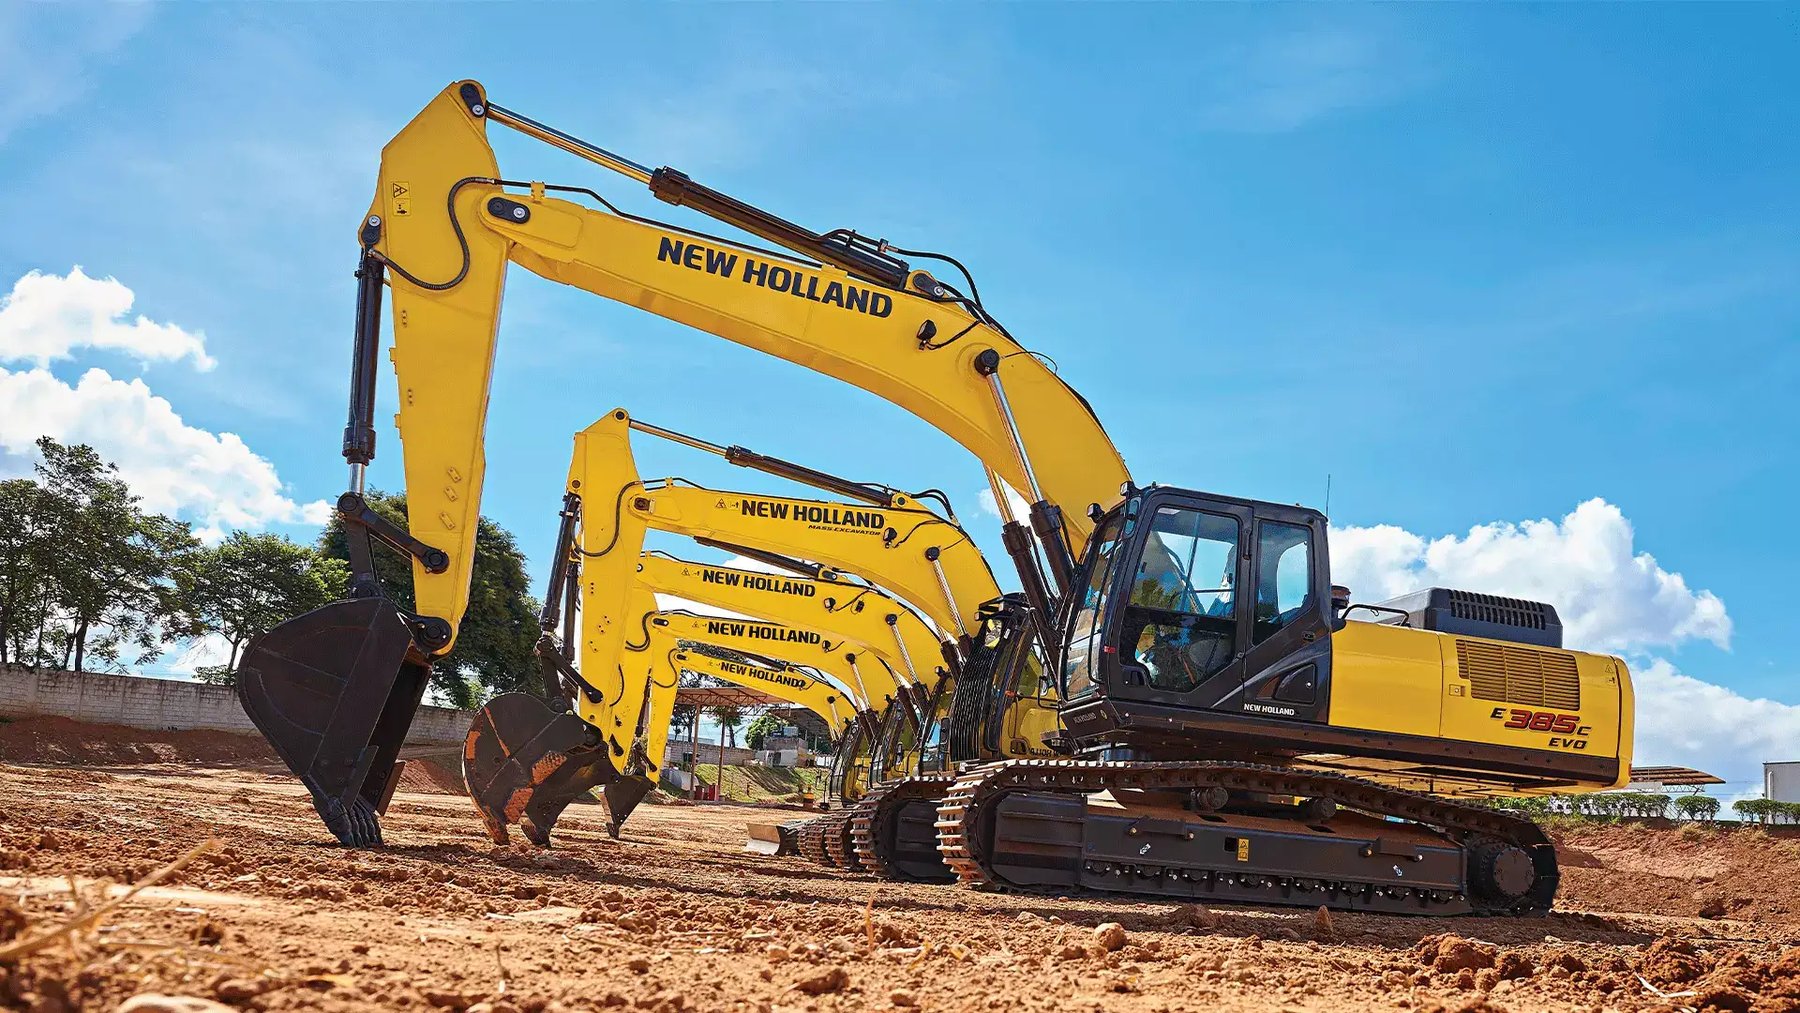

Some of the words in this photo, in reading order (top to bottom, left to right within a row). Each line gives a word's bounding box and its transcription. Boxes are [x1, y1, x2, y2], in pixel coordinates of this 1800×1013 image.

[657, 236, 738, 278] NEW
[742, 258, 893, 318] HOLLAND
[741, 499, 789, 519] NEW
[793, 505, 885, 529] HOLLAND
[833, 527, 881, 536] EXCAVATOR
[702, 569, 740, 586] NEW
[743, 576, 816, 597] HOLLAND
[708, 621, 745, 637] NEW
[748, 626, 821, 644] HOLLAND
[720, 661, 747, 675] NEW
[748, 668, 799, 688] HOLLAND
[1244, 703, 1262, 713] NEW
[1262, 704, 1295, 716] HOLLAND
[1548, 737, 1588, 750] EVO
